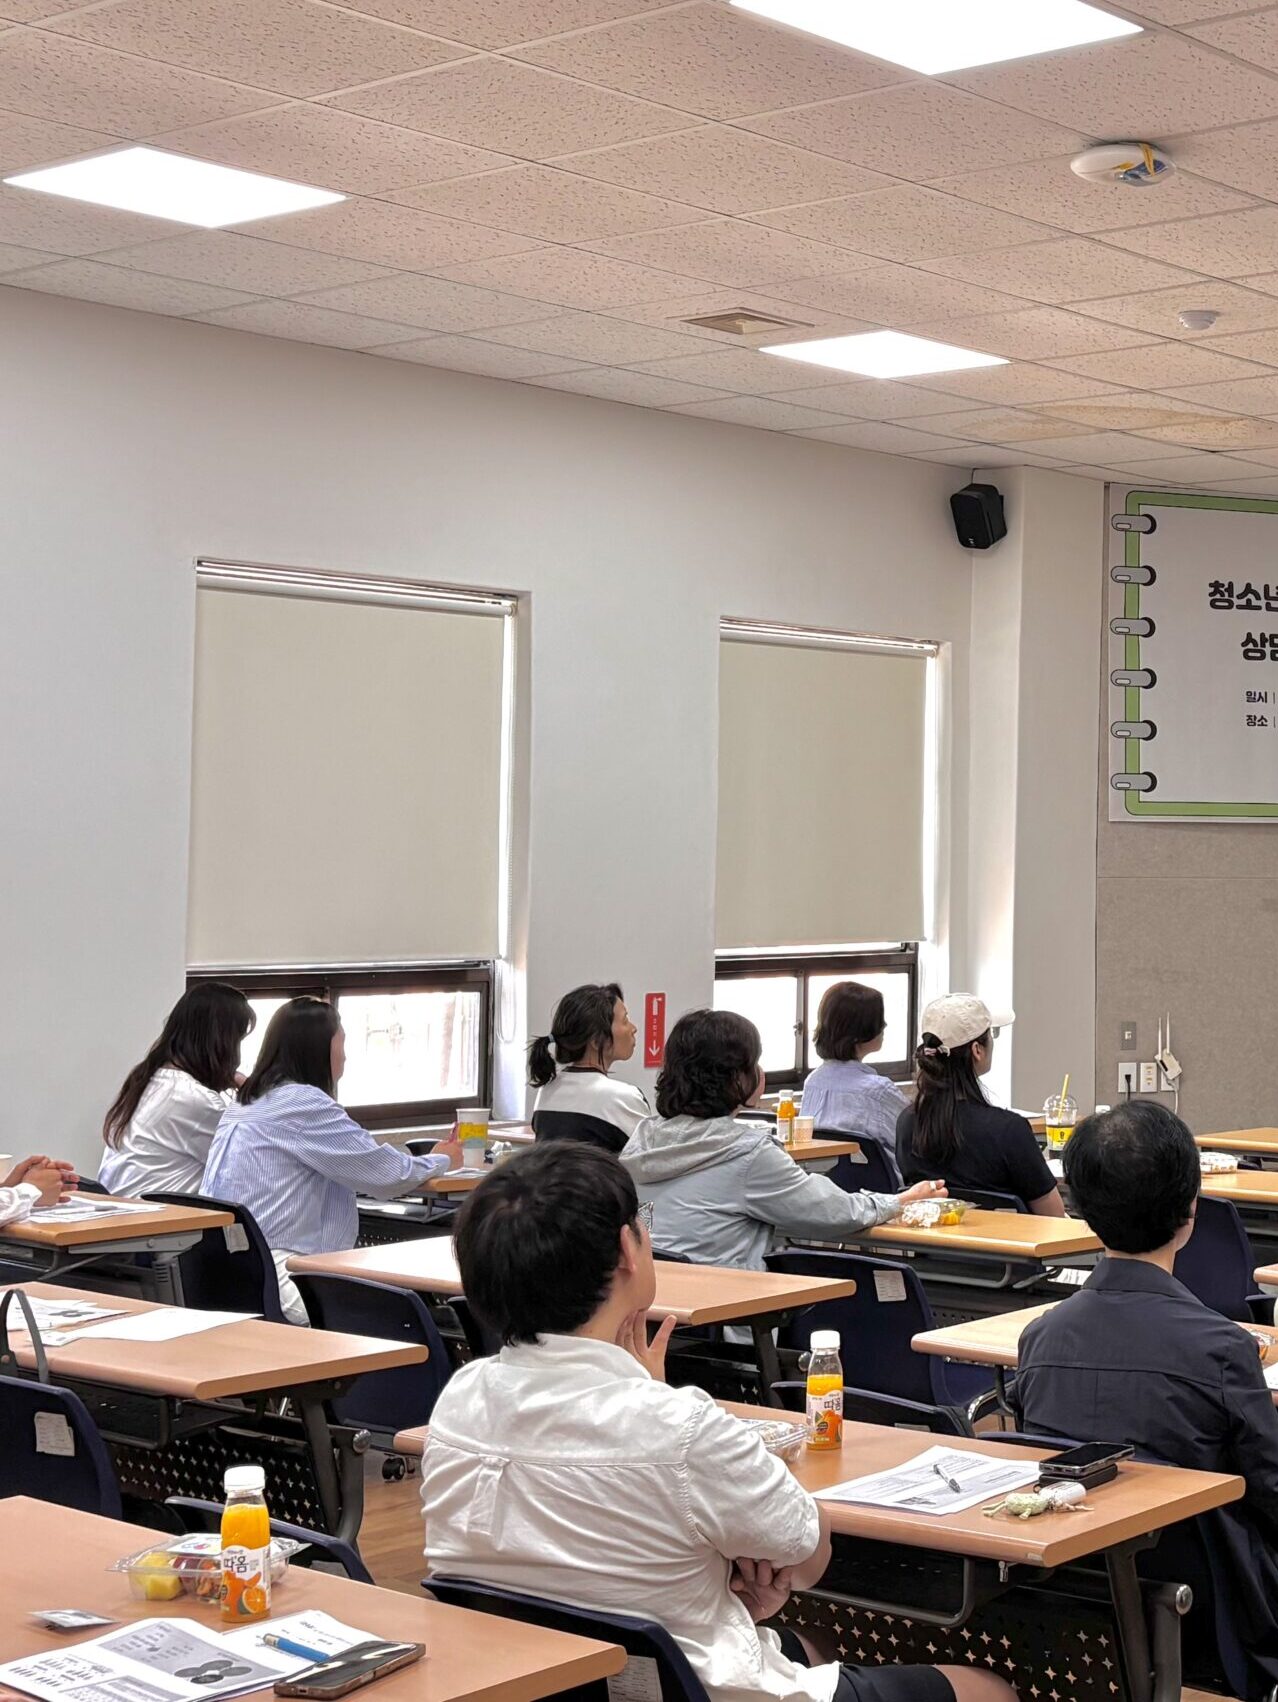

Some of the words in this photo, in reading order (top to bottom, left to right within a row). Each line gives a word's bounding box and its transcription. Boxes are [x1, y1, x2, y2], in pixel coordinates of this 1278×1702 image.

[1246, 691, 1268, 703] 일시
[1246, 715, 1268, 727] 장소
[224, 1556, 248, 1573] 따옴
